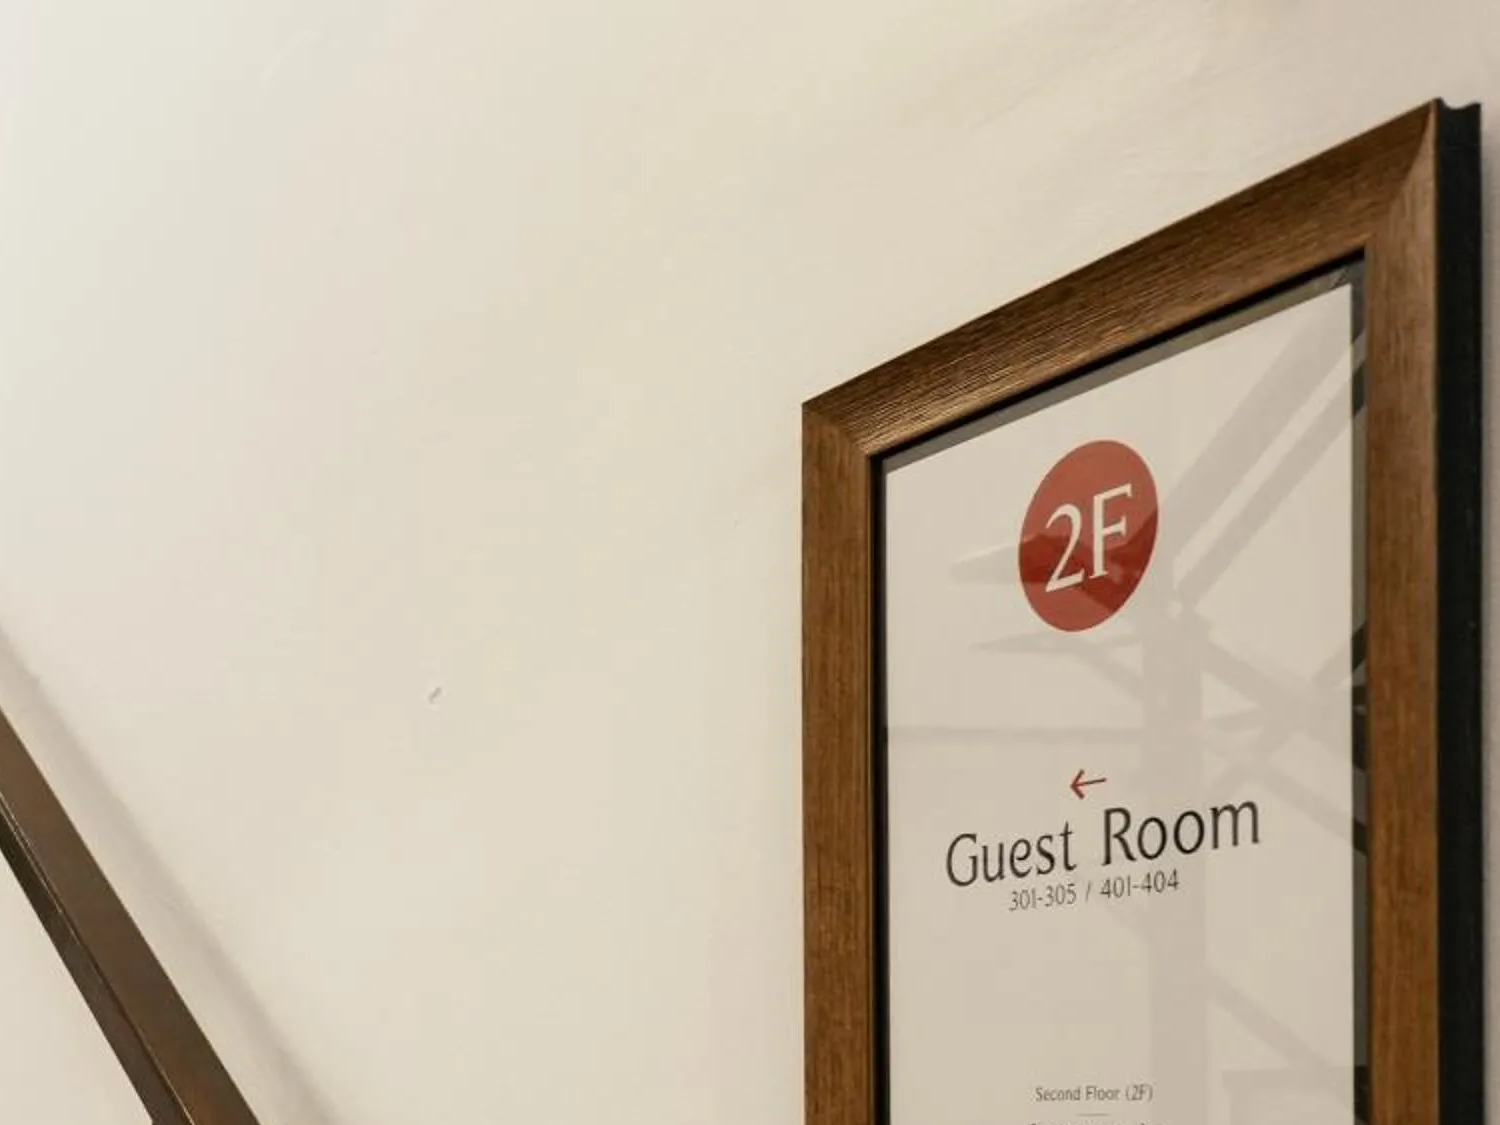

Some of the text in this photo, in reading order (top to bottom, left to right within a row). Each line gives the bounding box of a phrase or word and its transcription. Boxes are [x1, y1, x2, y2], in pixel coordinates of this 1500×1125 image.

[1044, 483, 1132, 592] 2F
[946, 800, 1261, 888] Guest Room
[1008, 868, 1180, 911] 301-305 / 401-404
[1035, 1083, 1153, 1102] Second Floor (2F)
